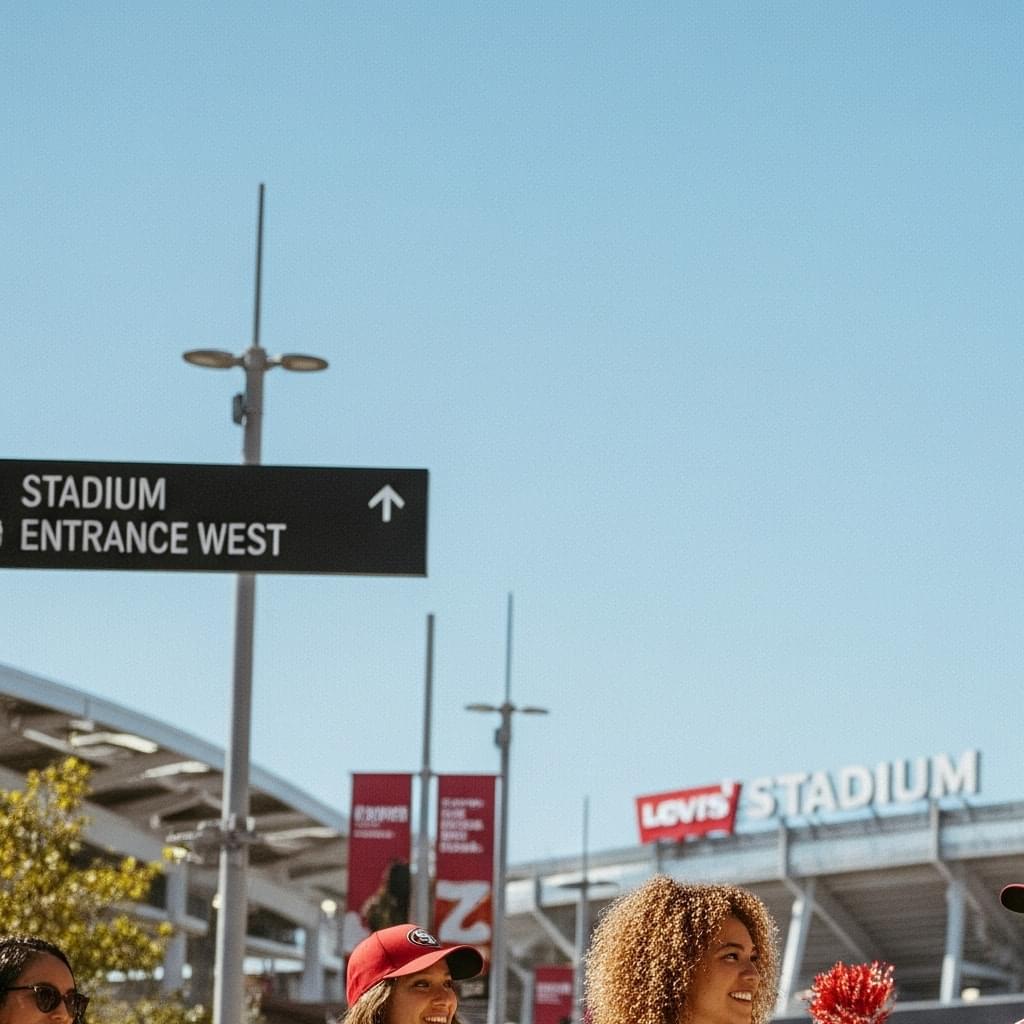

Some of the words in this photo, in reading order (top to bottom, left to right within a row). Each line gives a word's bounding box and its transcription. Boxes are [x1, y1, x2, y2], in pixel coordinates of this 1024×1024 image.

[21, 474, 166, 511] STADIUM
[20, 519, 189, 554] ENTRANCE
[197, 522, 287, 556] WEST
[746, 751, 981, 820] STADIUM
